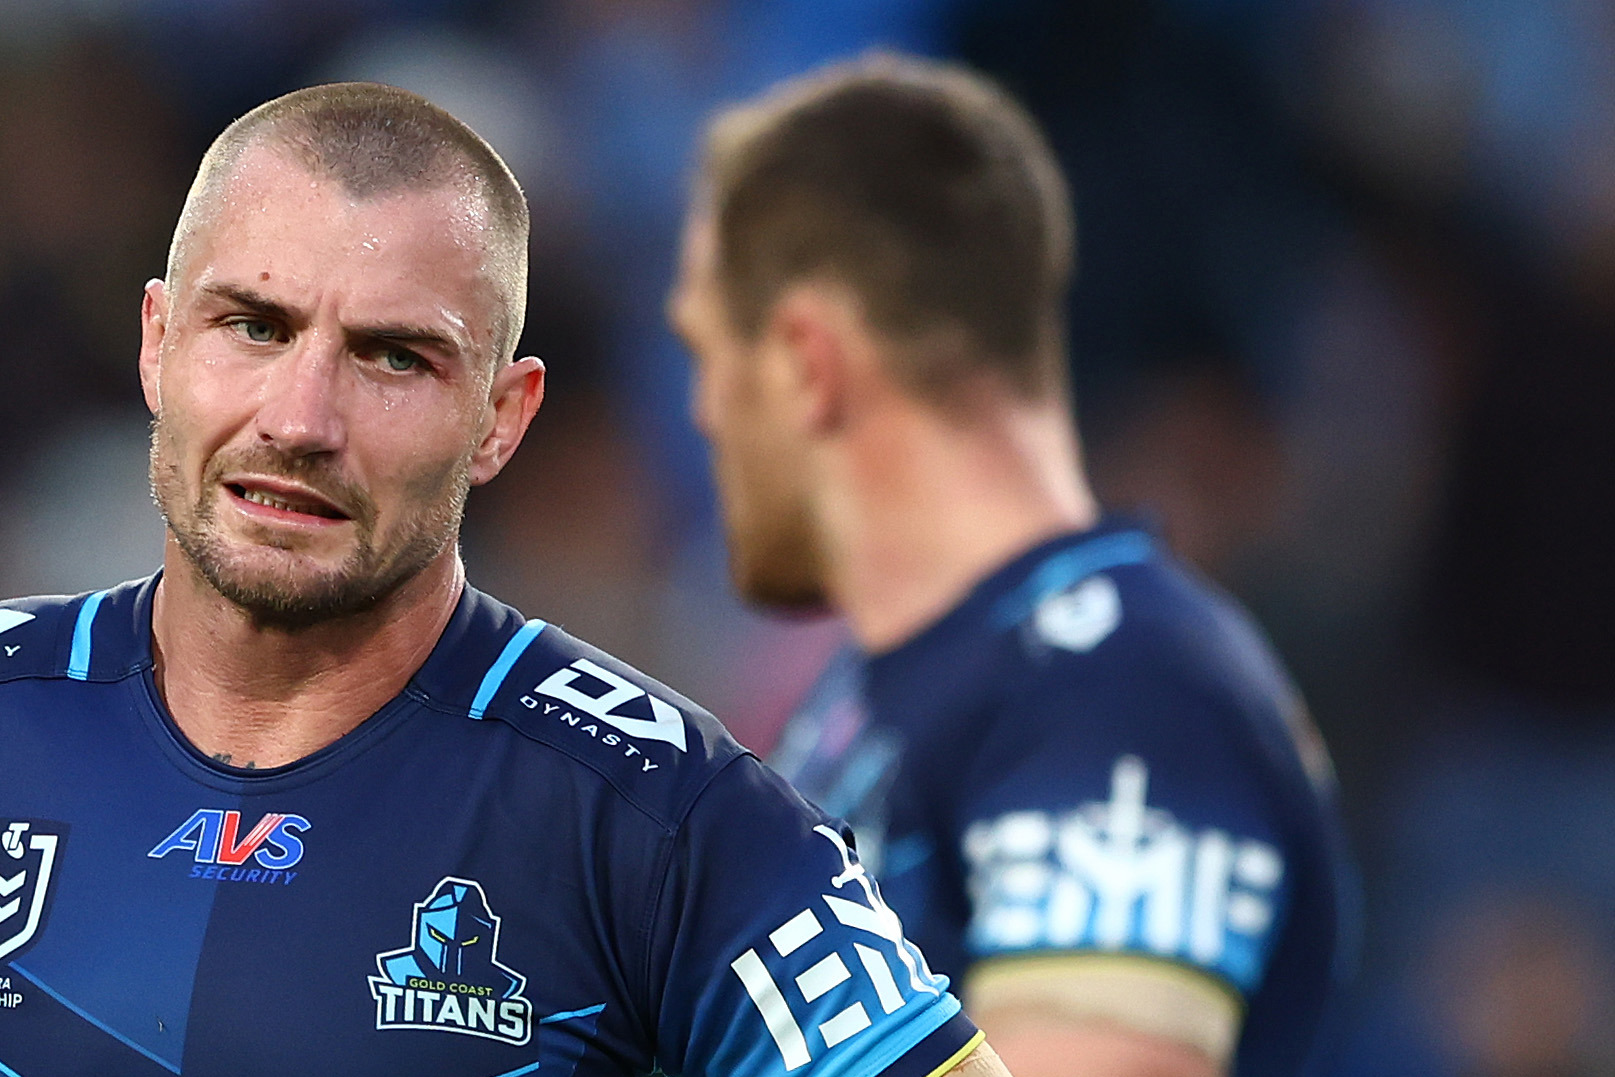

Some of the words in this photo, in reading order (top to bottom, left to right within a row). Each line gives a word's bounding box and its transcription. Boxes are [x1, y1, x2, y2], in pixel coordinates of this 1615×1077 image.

[519, 694, 659, 773] DYNASTY
[147, 808, 312, 870] AVS
[188, 865, 298, 886] SECURITY
[378, 985, 525, 1039] TITANS
[409, 977, 446, 991] GOLD
[449, 983, 493, 996] COAST
